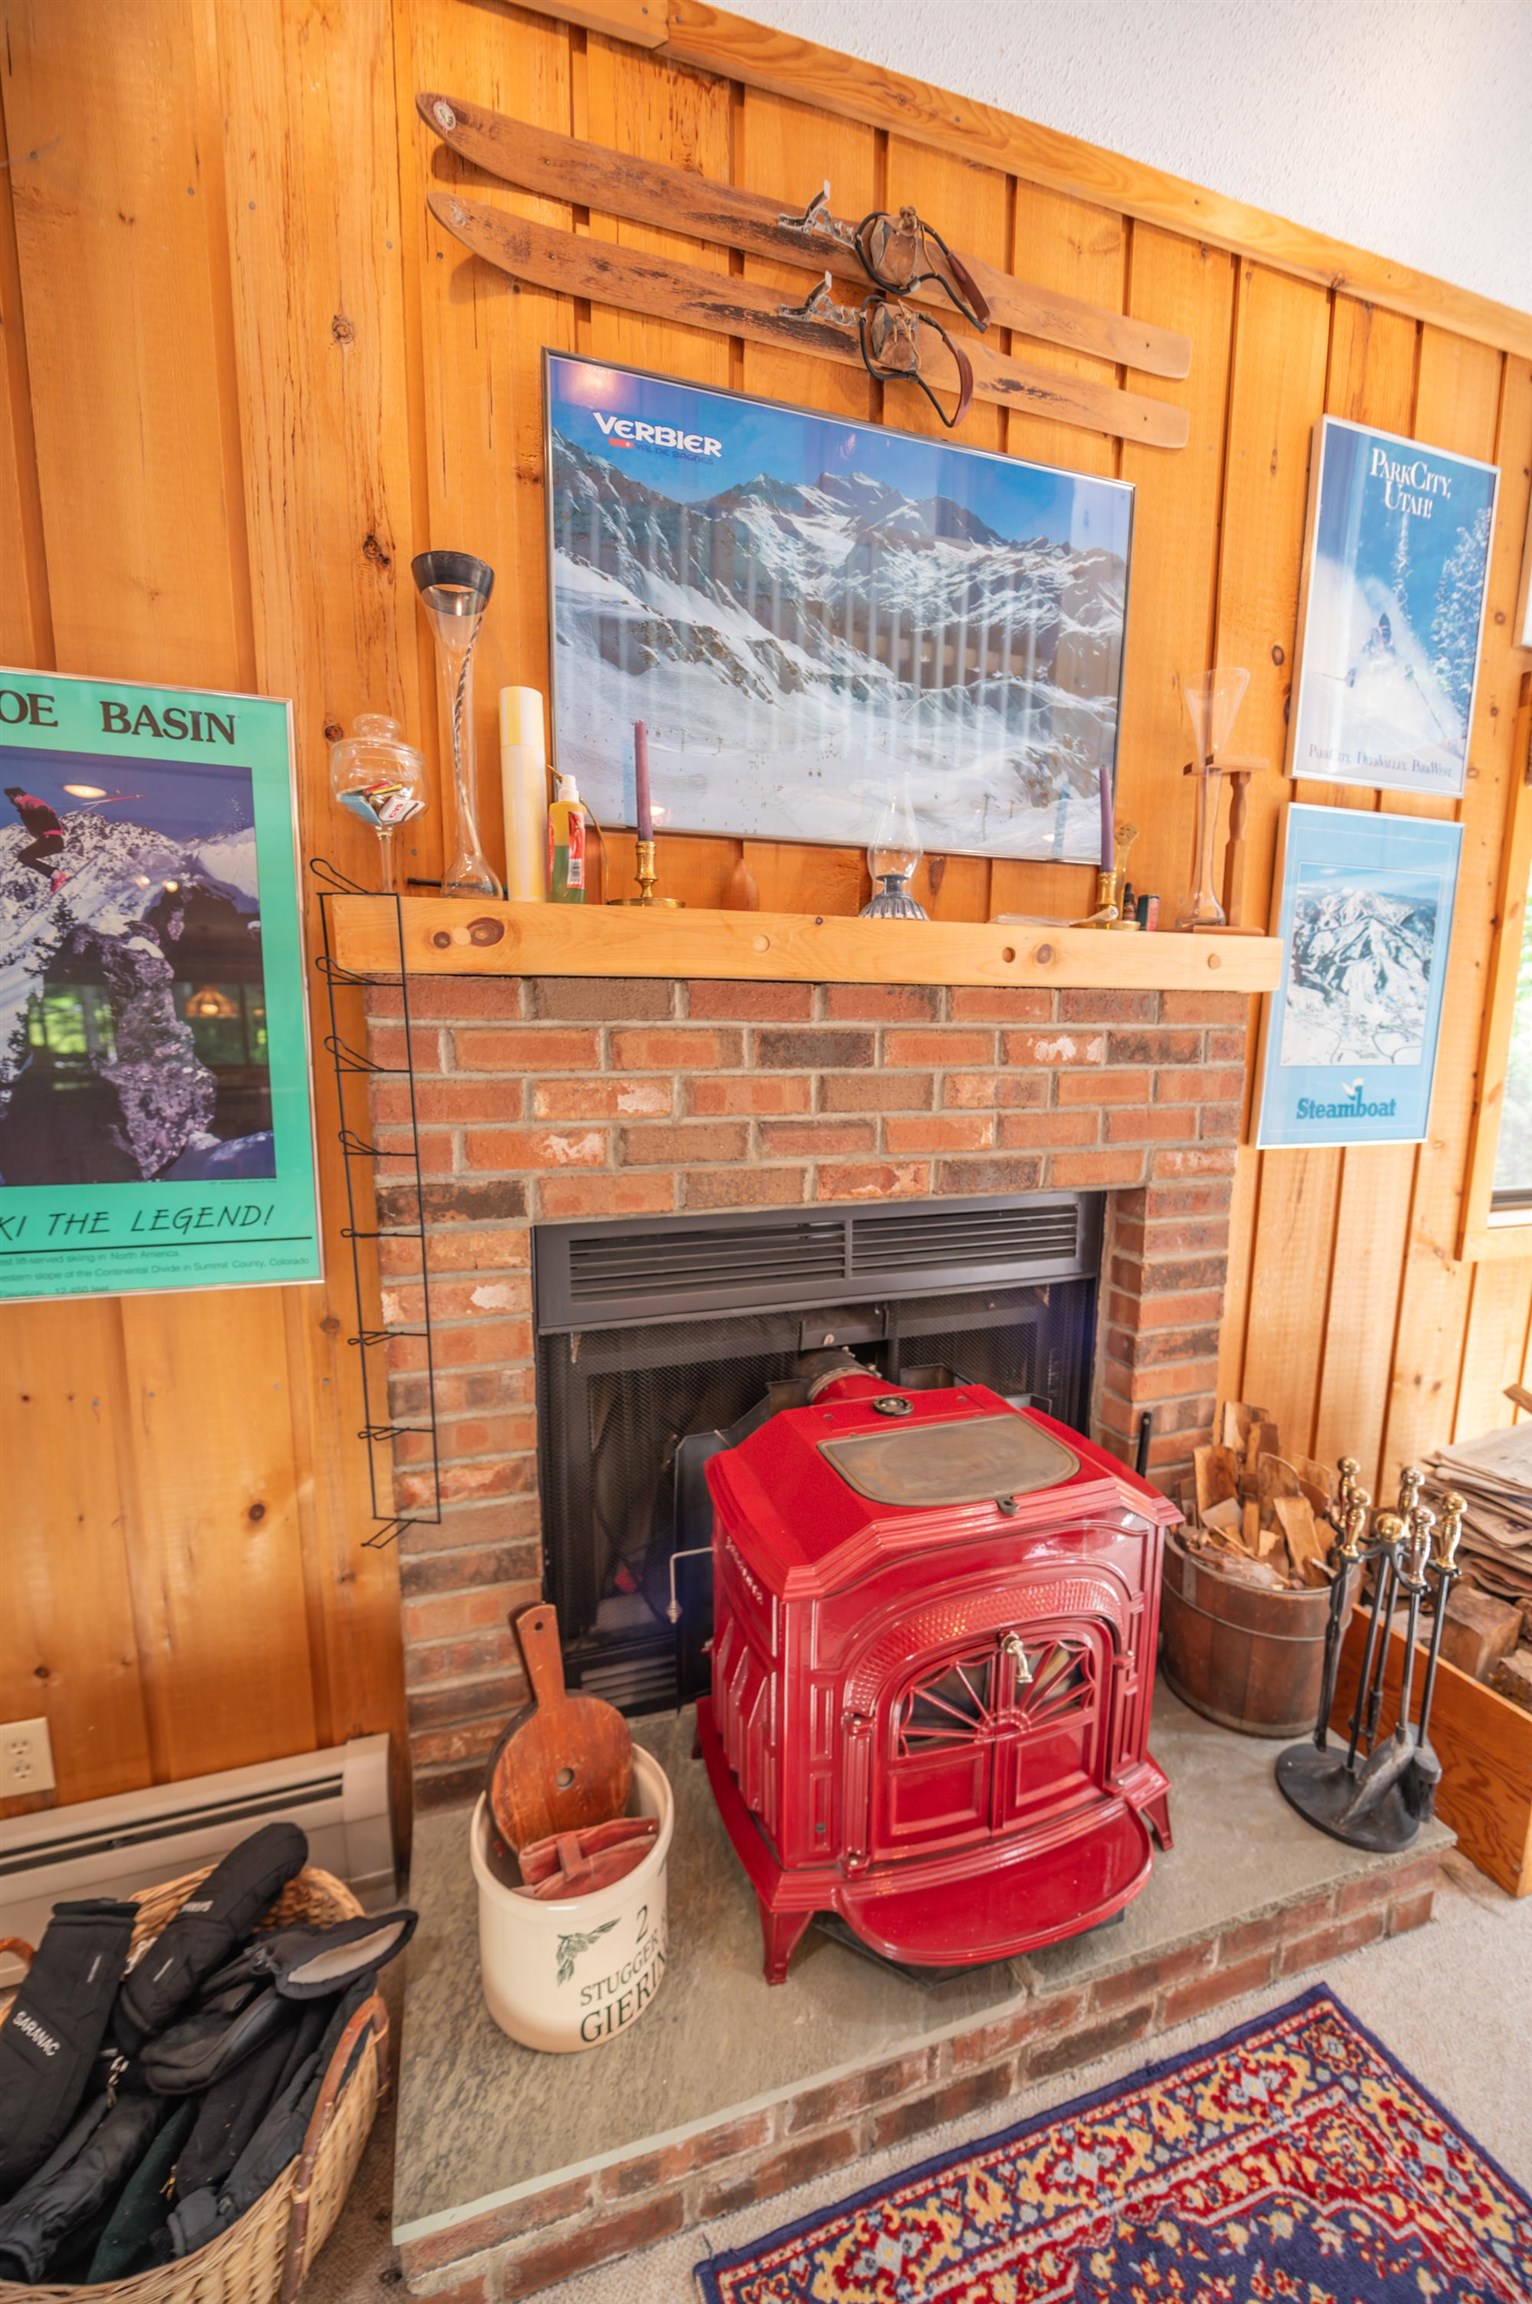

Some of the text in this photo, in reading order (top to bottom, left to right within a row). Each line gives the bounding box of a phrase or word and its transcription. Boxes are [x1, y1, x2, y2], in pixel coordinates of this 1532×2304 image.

[593, 412, 723, 458] VERBIER
[1384, 480, 1433, 518] UTAH!
[0, 689, 236, 746] OE BASIN
[1296, 1085, 1396, 1120] Steamboat
[48, 1211, 110, 1236] THE
[130, 1204, 275, 1235] LEGEND!
[635, 1904, 648, 1945] 2
[12, 2010, 61, 2057] SARANAC
